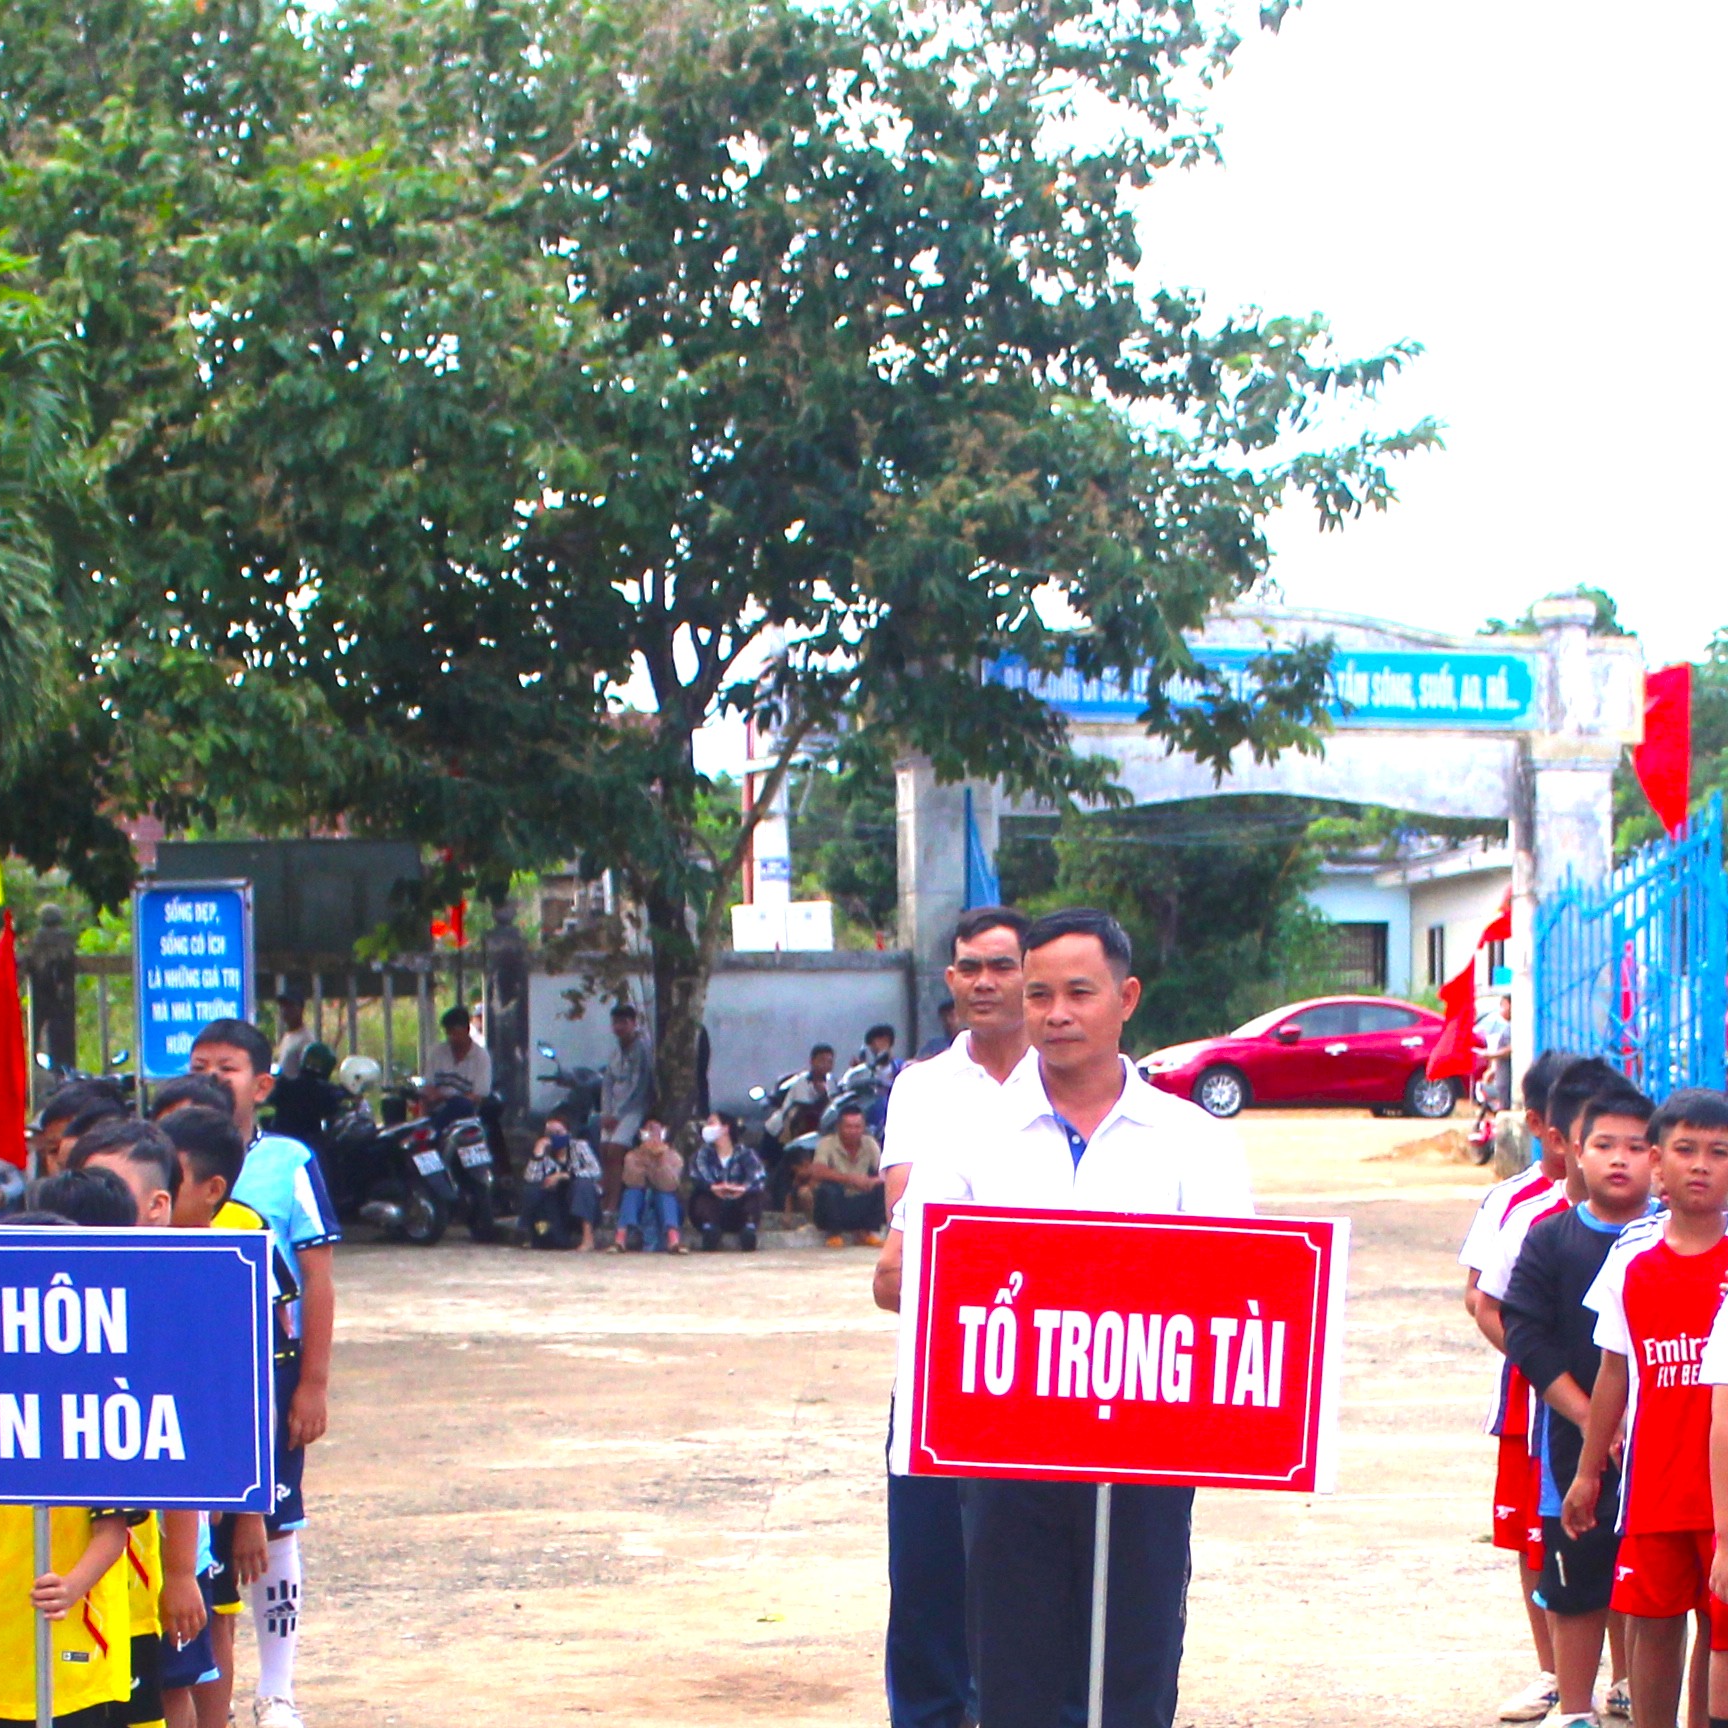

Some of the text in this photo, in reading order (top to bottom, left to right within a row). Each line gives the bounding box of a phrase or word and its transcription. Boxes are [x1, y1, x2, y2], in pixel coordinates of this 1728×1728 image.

[959, 1271, 1285, 1419] TỔ TRỌNG TÀI
[1657, 1364, 1700, 1388] FLY BE
[62, 1377, 185, 1460] HÒA
